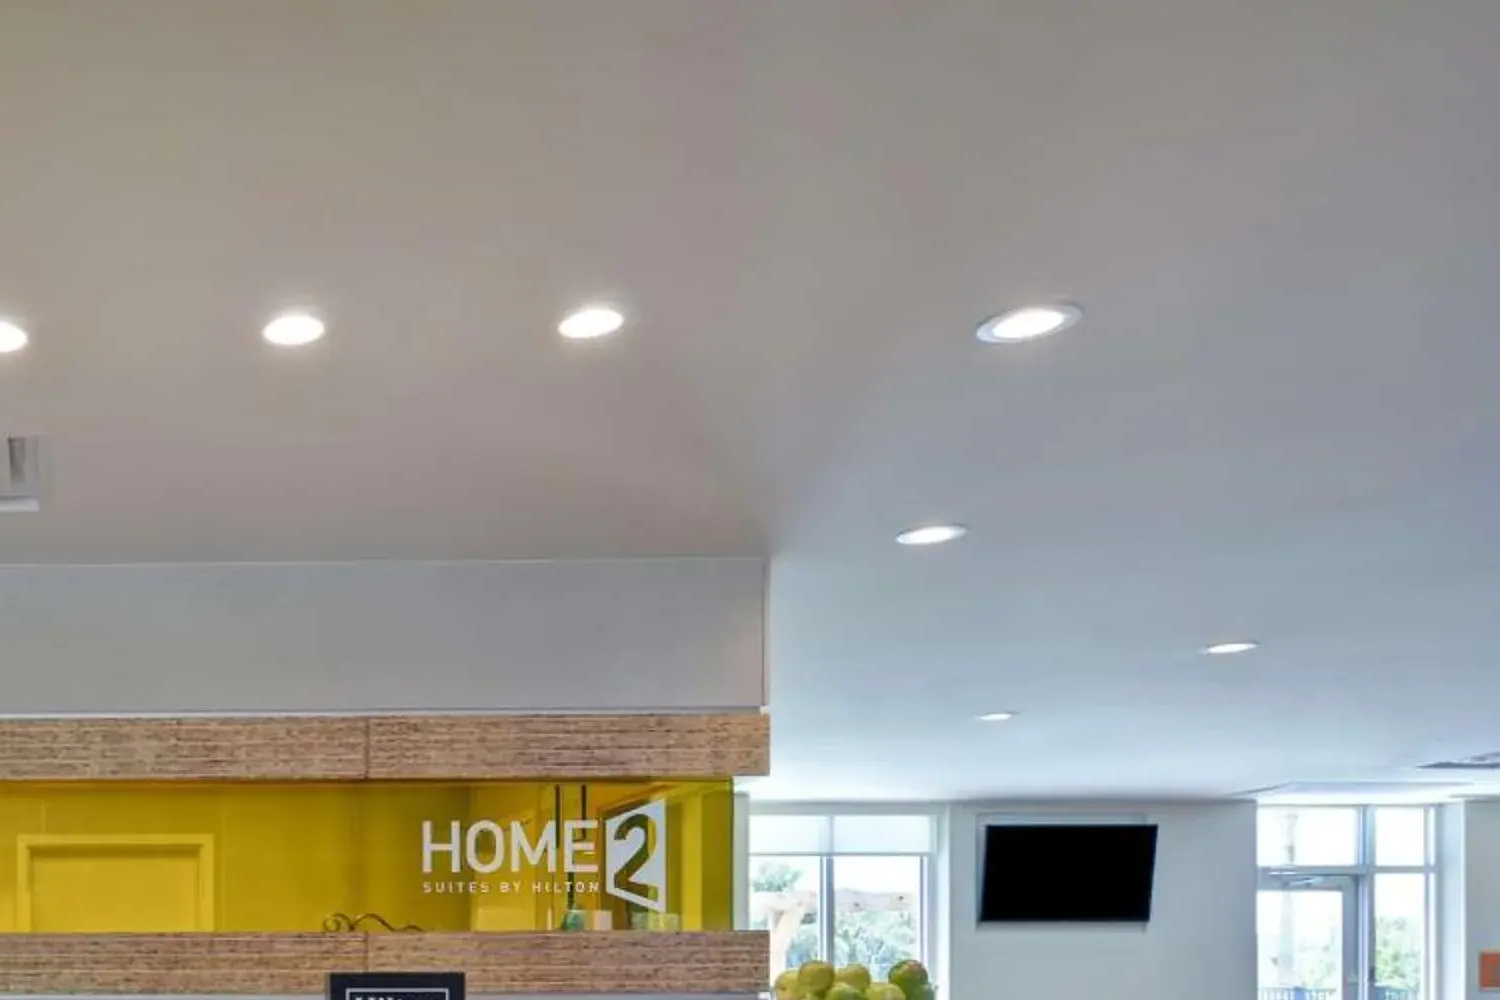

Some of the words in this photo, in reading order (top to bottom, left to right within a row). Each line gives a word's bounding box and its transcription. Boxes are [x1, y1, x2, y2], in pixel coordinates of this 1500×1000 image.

[422, 880, 490, 894] SUITES
[500, 881, 522, 894] BY
[531, 881, 600, 894] HILTON
